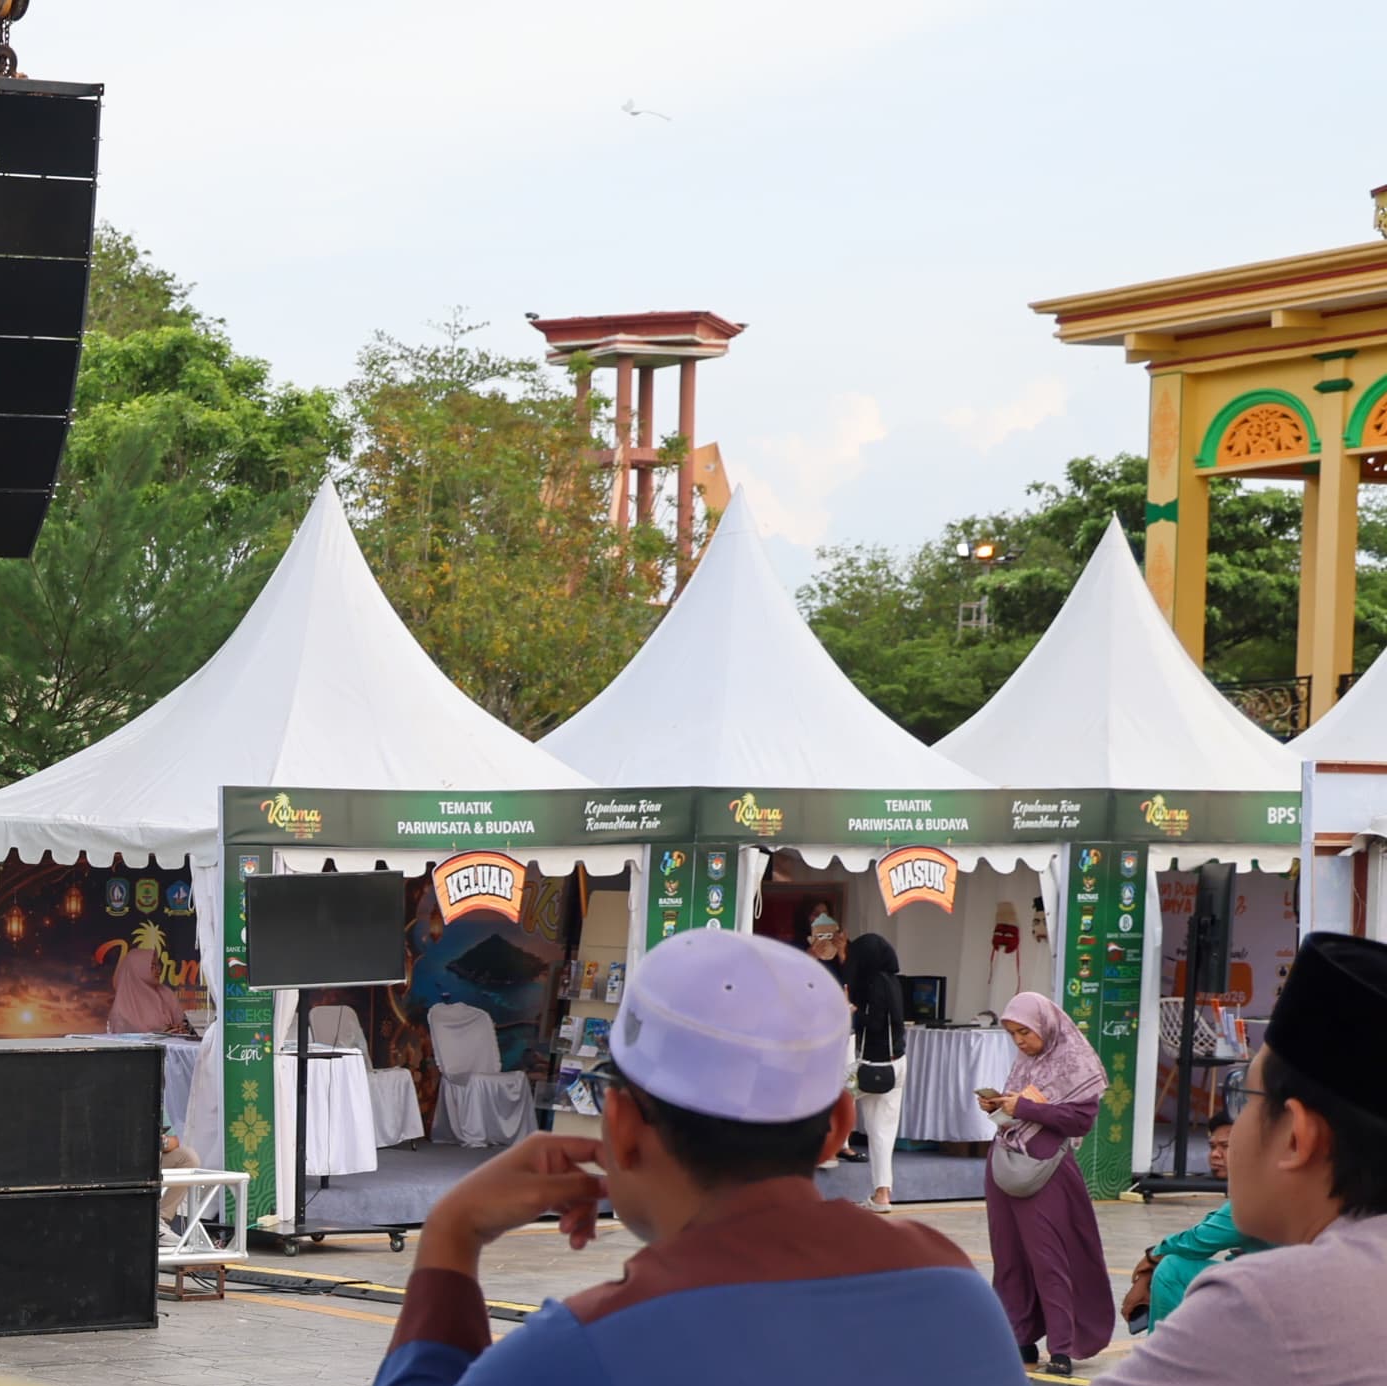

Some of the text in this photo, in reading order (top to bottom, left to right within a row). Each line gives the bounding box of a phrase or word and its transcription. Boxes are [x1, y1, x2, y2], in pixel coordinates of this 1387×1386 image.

[259, 796, 322, 828] Kurma
[439, 801, 493, 815] TEMATIK
[584, 799, 662, 818] Kepulauan Riau
[884, 799, 933, 813] TEMATIK
[585, 815, 661, 831] Ramadhan Fair
[1267, 806, 1296, 825] BPS
[397, 820, 535, 835] PARIWISATA & BUDAYA
[848, 818, 969, 832] PARIWISATA & BUDAYA
[444, 864, 515, 904] KELUAR
[887, 858, 947, 897] MASUK
